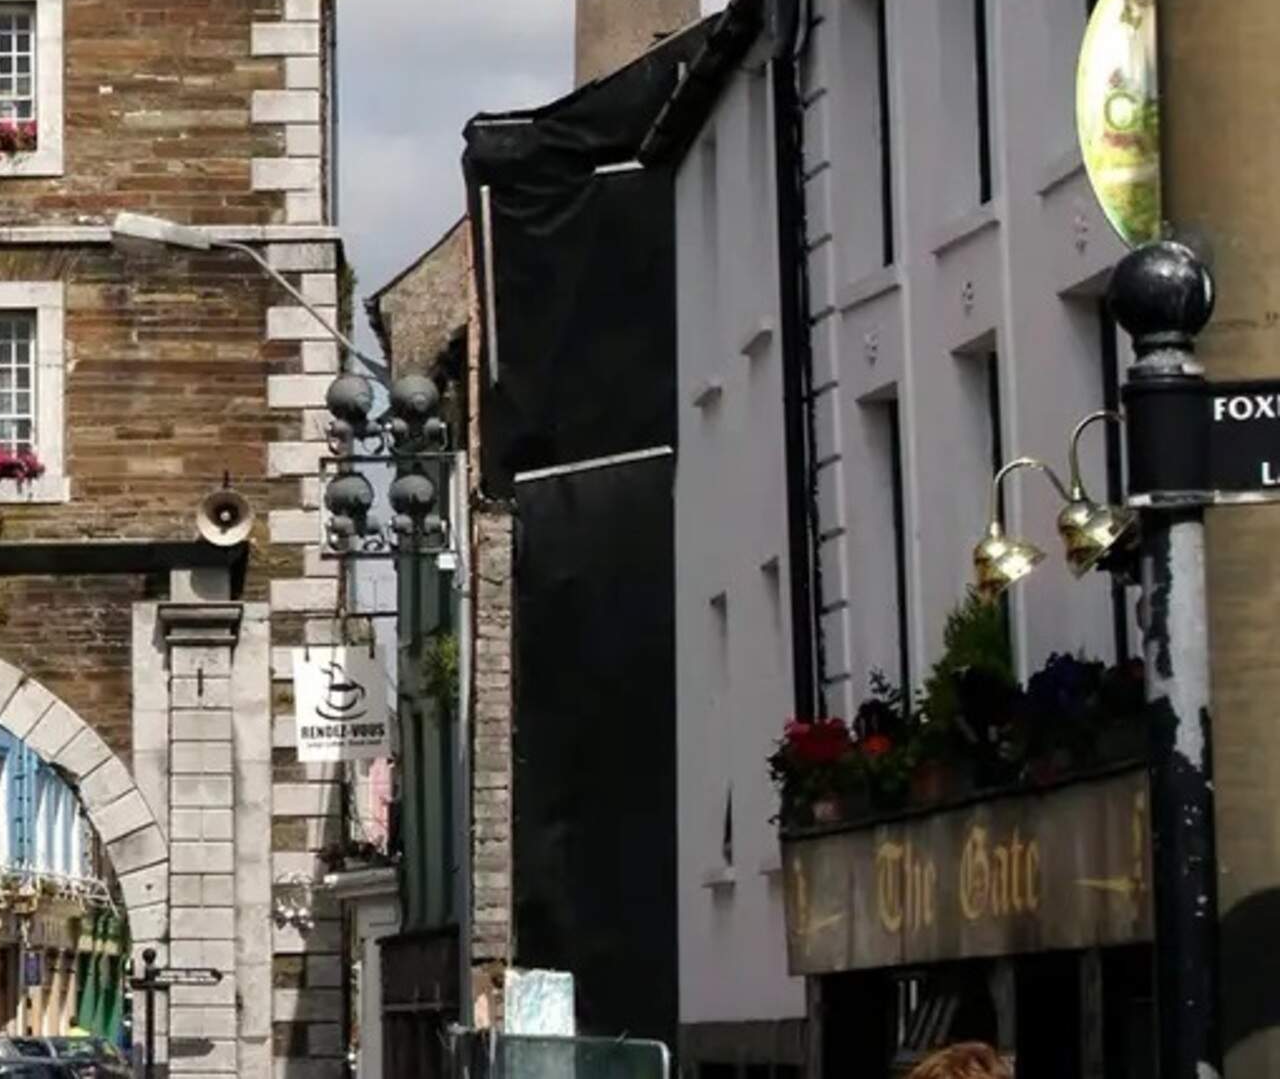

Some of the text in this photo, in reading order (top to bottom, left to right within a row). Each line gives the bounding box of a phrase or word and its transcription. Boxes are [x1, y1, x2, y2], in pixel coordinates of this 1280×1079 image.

[1214, 394, 1280, 421] FOX
[1262, 462, 1280, 485] L
[874, 824, 1040, 933] The Gate
